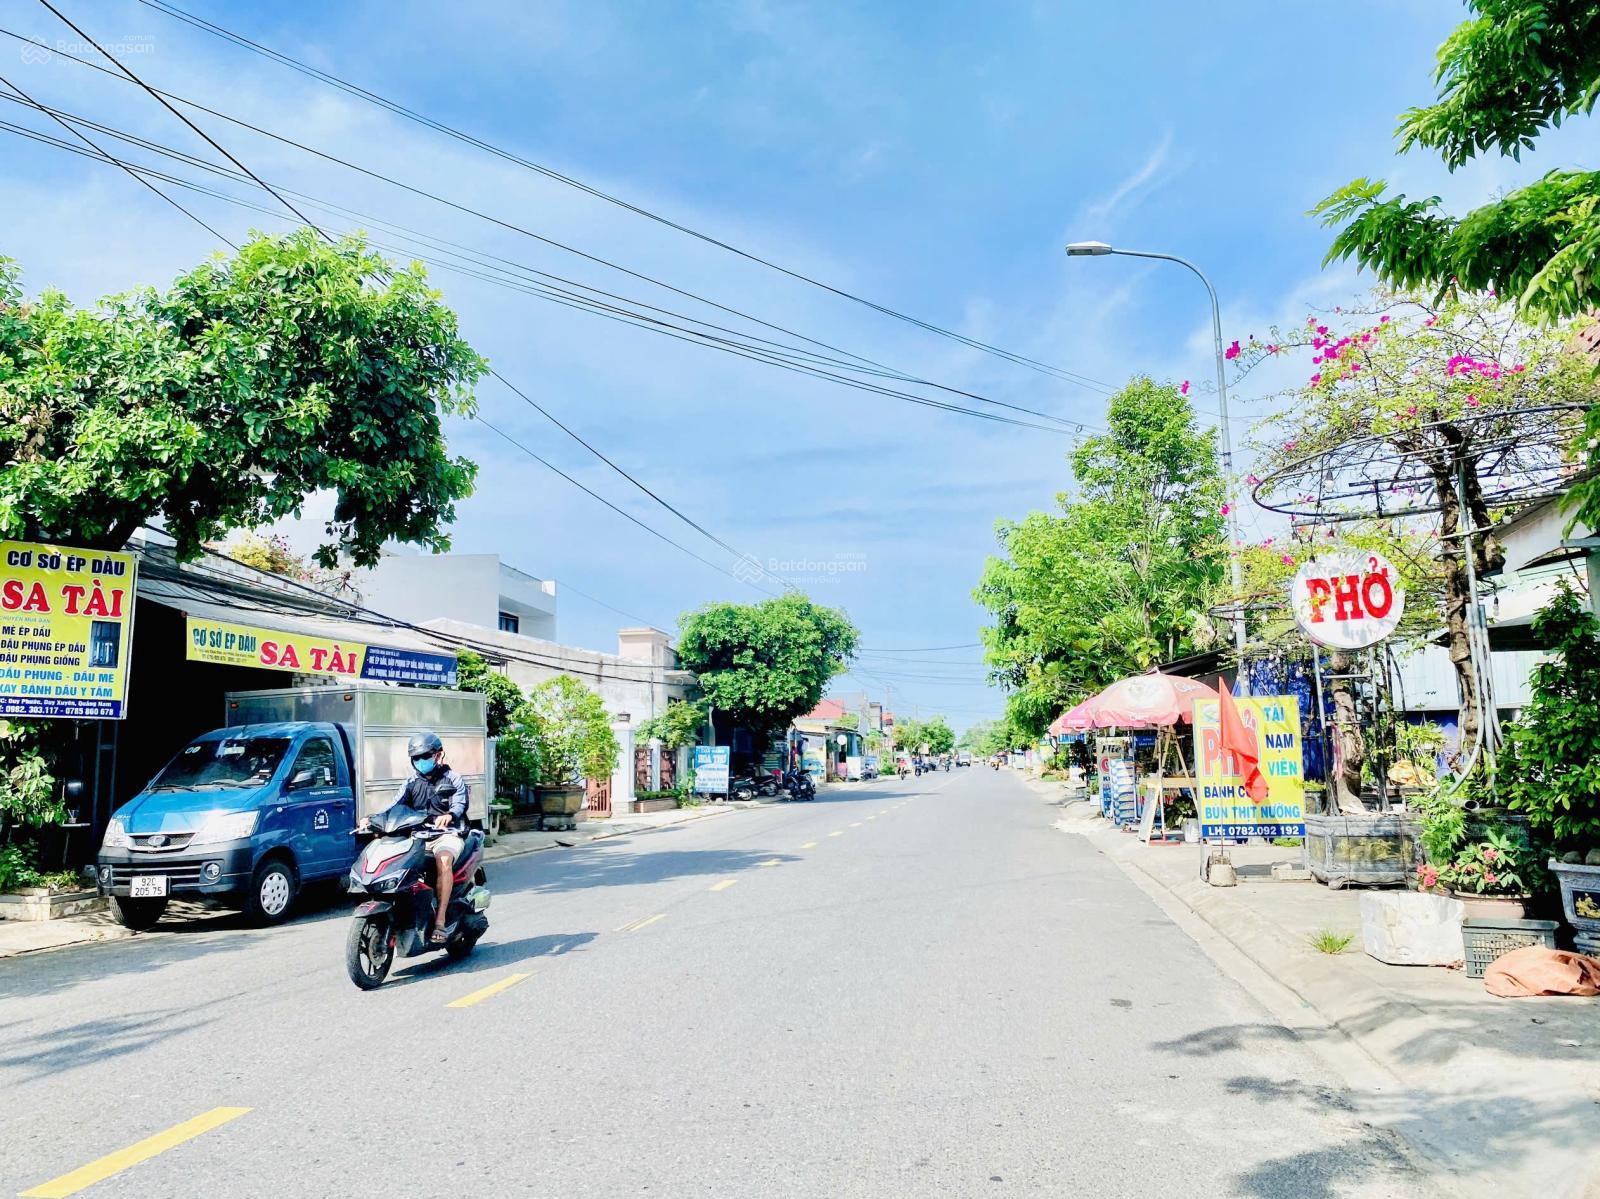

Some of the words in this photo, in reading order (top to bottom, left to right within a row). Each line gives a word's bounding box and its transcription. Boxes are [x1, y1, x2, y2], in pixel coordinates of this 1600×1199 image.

[7, 550, 33, 567] CƠ
[38, 551, 62, 570] SỞ
[66, 555, 87, 572] ÉP
[91, 555, 125, 576] DẦU
[2, 580, 51, 612] SA
[61, 579, 125, 617] TÀI
[1306, 556, 1393, 624] PHỞ
[260, 641, 301, 668] SA
[310, 644, 358, 674] TÀI
[1265, 733, 1294, 753] NẠM
[1228, 826, 1277, 836] 0782.092
[1280, 825, 1299, 835] 192
